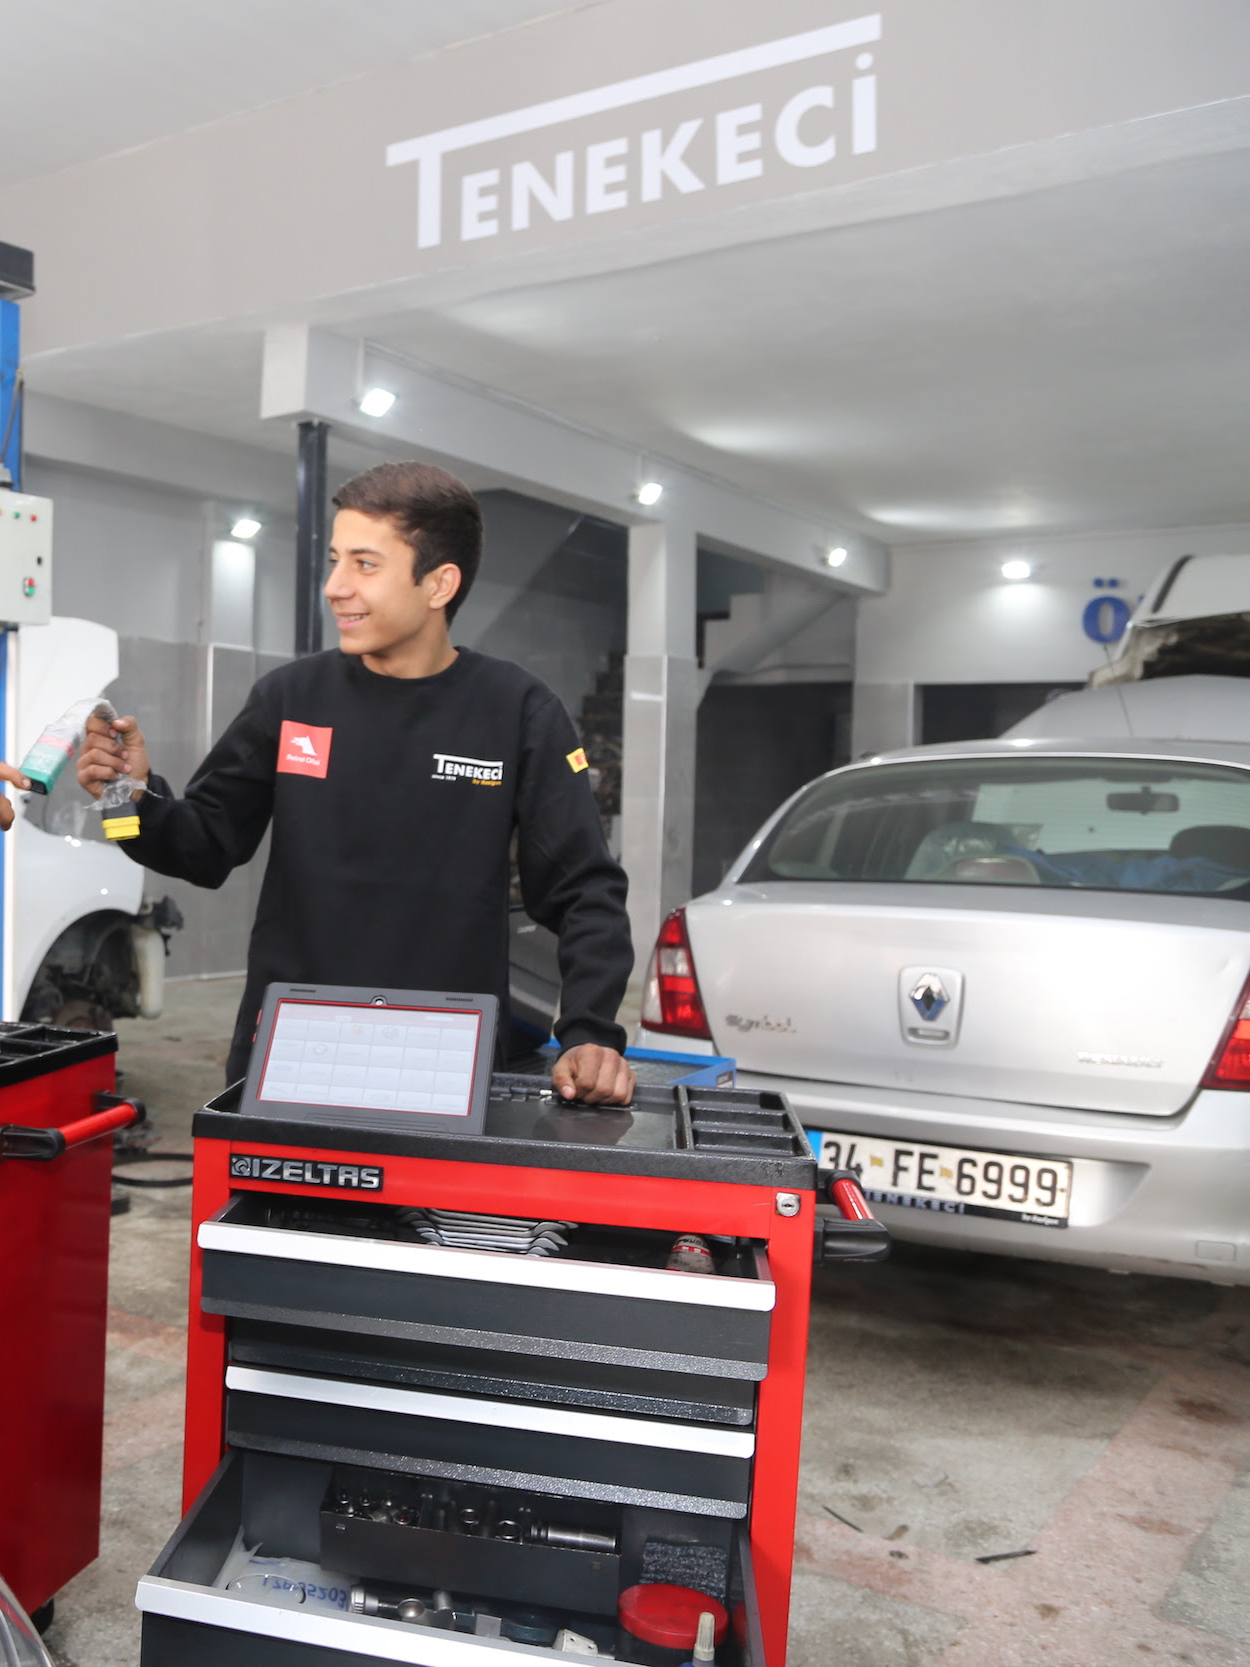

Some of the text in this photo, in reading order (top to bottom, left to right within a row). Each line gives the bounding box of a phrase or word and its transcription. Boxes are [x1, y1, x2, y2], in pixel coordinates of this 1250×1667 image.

[823, 1141, 1059, 1207] 34 FE 6999
